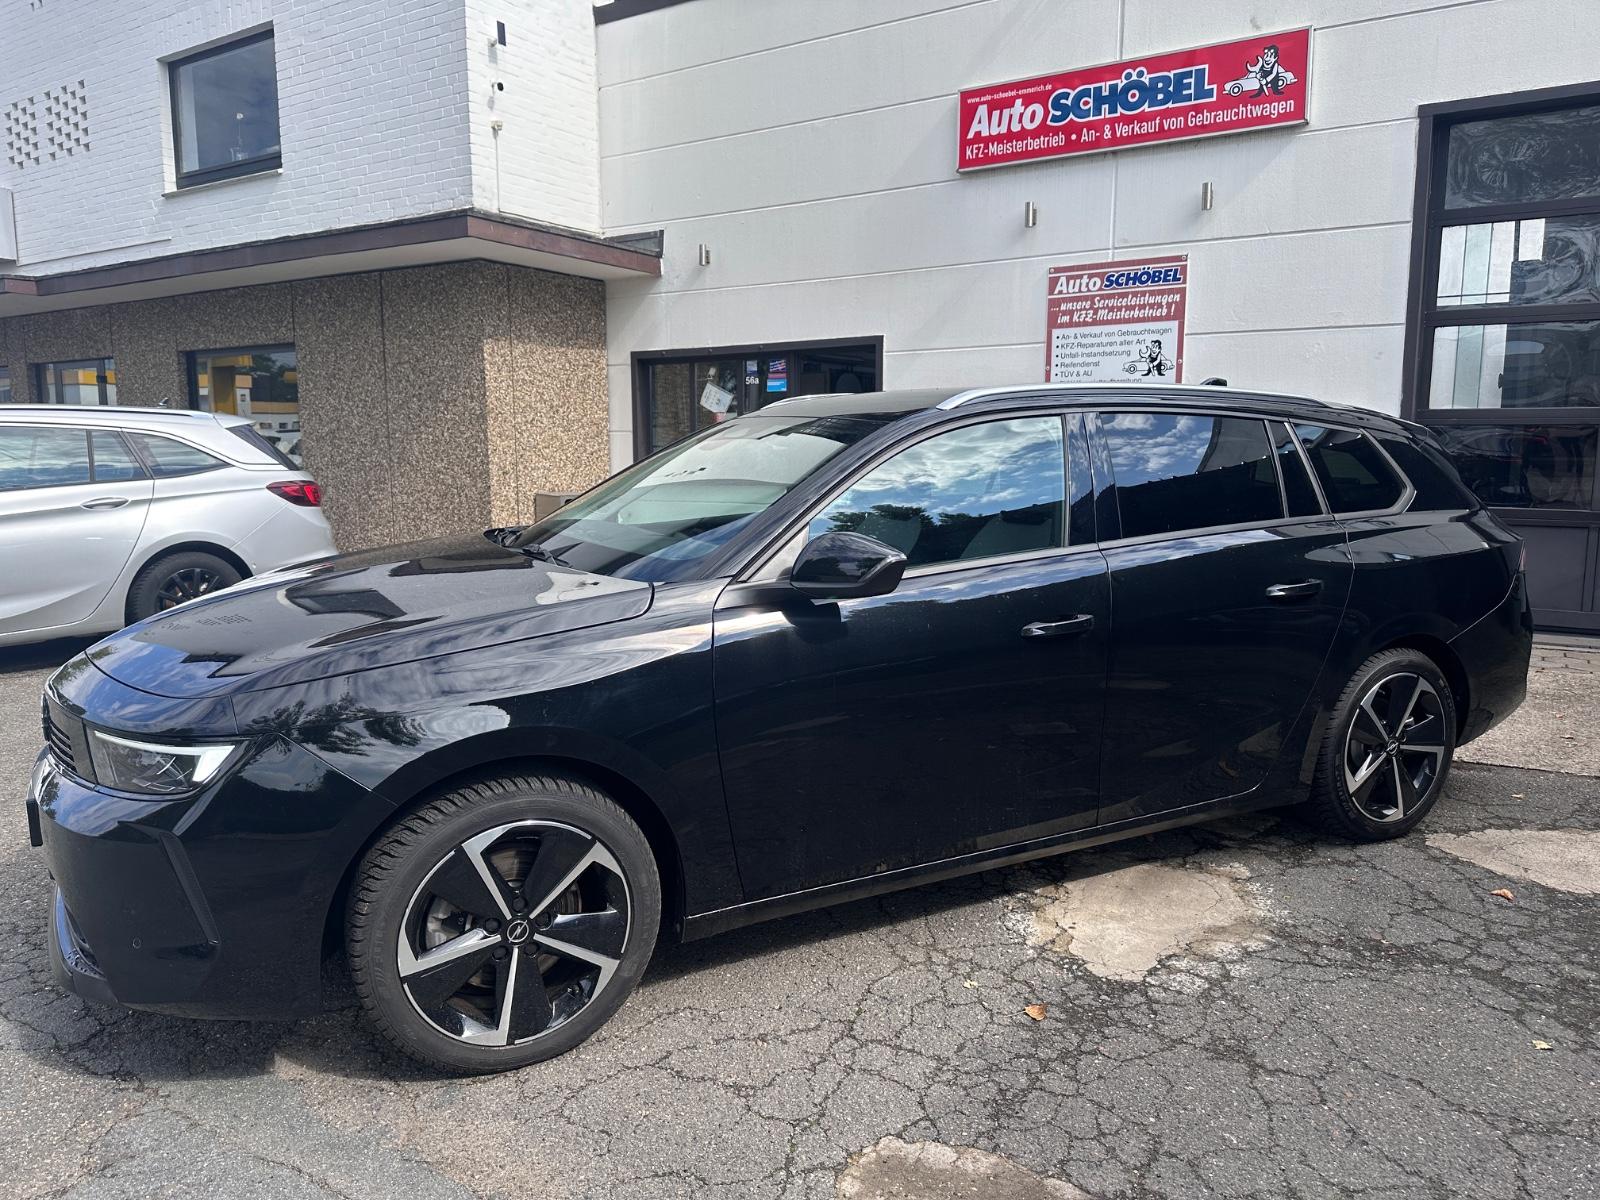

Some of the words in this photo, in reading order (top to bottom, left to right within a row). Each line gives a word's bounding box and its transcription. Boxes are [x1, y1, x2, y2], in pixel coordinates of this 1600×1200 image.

[967, 83, 1053, 104] www.auto-schoebel-emmerich.de
[966, 98, 1044, 139] Auto
[1047, 65, 1217, 126] SCHÖBEL
[965, 132, 1066, 160] KFZ-Meisterbetrieb
[1080, 127, 1101, 143] An-
[1103, 126, 1112, 140] &
[1115, 118, 1161, 139] Verkauf
[1164, 116, 1185, 131] von
[1187, 98, 1295, 128] Gebrauchtwagen
[1053, 276, 1101, 295] Auto
[1103, 267, 1182, 290] SCHÖBEL
[1093, 292, 1181, 308] Serviceleistungen
[1057, 313, 1070, 324] im
[1072, 304, 1168, 323] KFZ-Meisterbetrieb
[1170, 306, 1175, 316] !
[1073, 332, 1079, 340] &
[1080, 330, 1103, 339] Verkauf
[1117, 327, 1173, 337] Gebrauchtwagen
[1060, 341, 1117, 351] KFZ-Reparaturen
[1118, 339, 1134, 347] aller
[1136, 338, 1147, 346] Art
[1060, 349, 1131, 360] Unfall-Instandsetzung
[1060, 361, 1100, 369] Reifendienst
[745, 376, 760, 385] 56a
[1060, 369, 1075, 378] TÜV
[1075, 370, 1081, 378] &
[1082, 369, 1093, 378] AU
